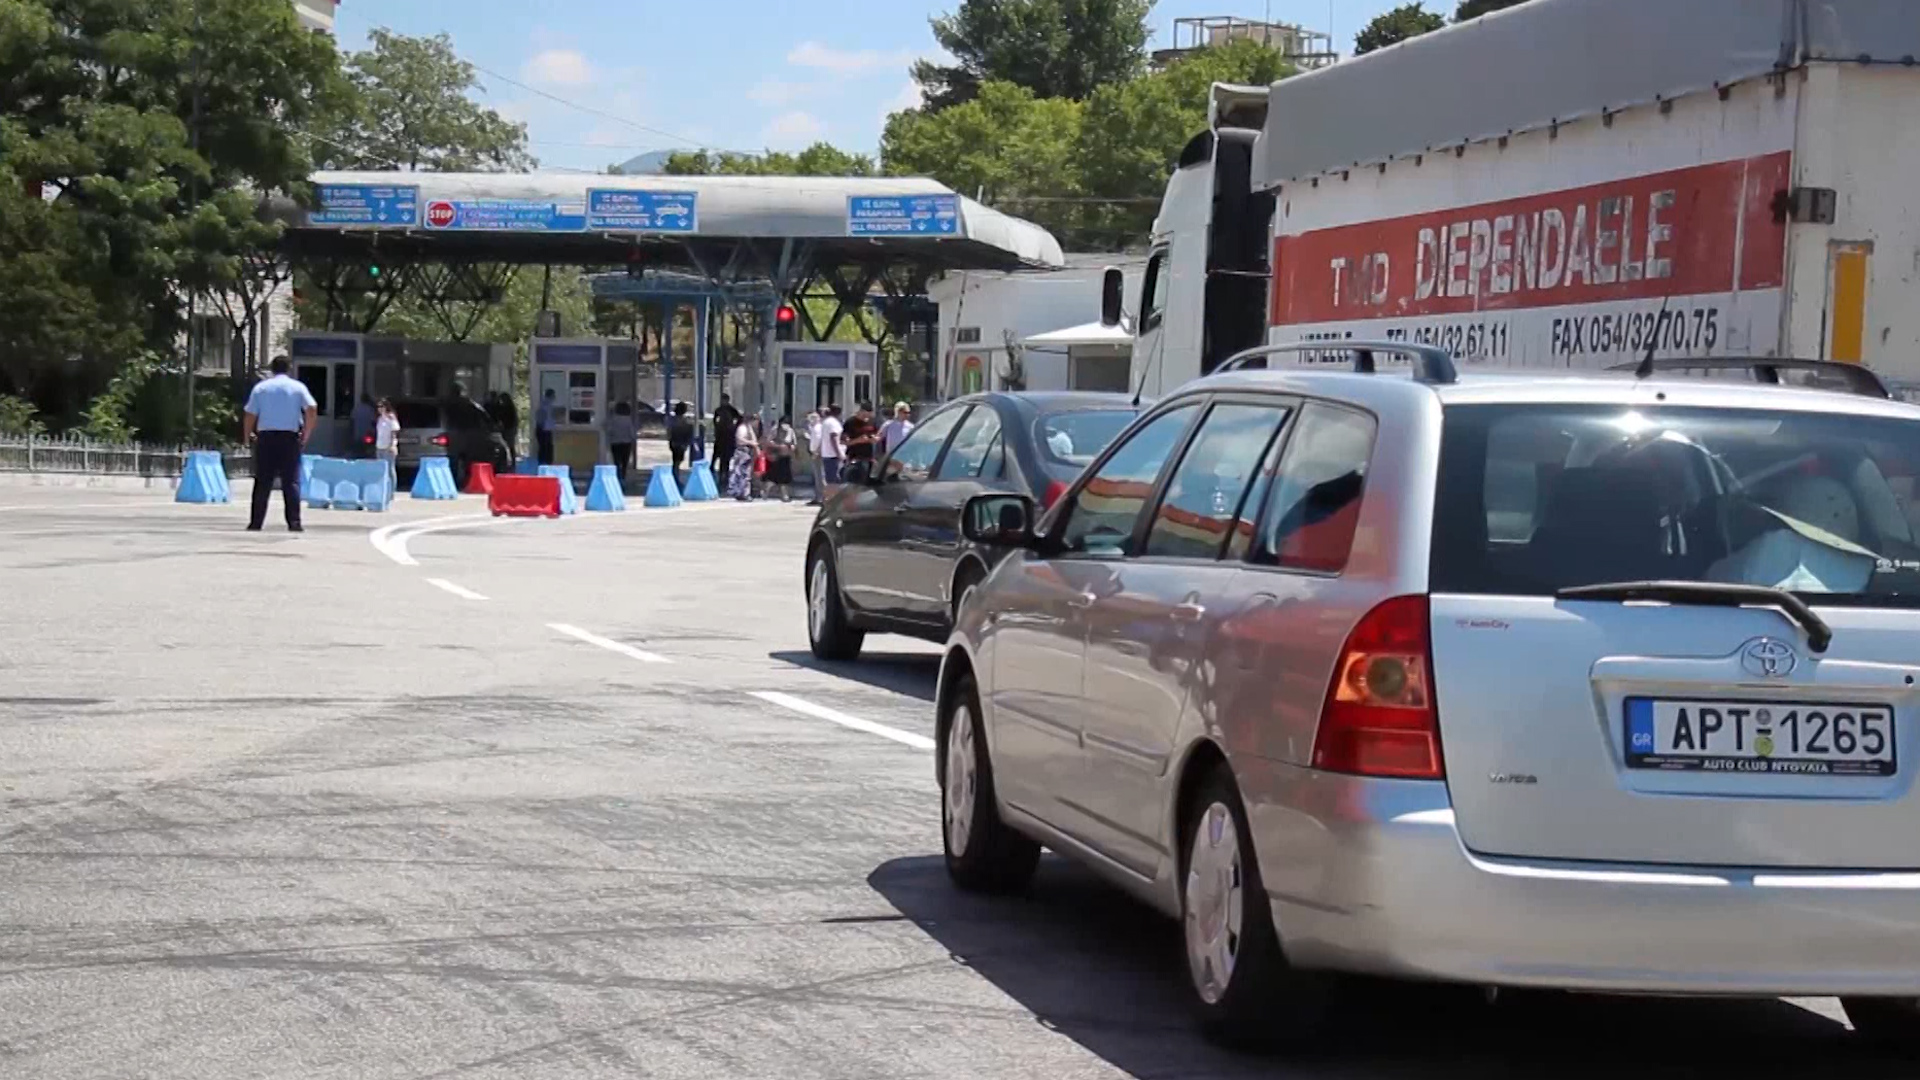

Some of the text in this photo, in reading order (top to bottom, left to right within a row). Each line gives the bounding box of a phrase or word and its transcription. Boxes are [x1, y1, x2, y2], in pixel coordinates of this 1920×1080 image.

[429, 208, 453, 220] STOP
[1415, 189, 1676, 300] DIEPENDAELE
[1551, 317, 1586, 355] FAX
[1632, 732, 1652, 746] GR
[1672, 707, 1885, 754] APT 1265
[1702, 759, 1735, 769] AUTO
[1737, 760, 1768, 771] CLUB
